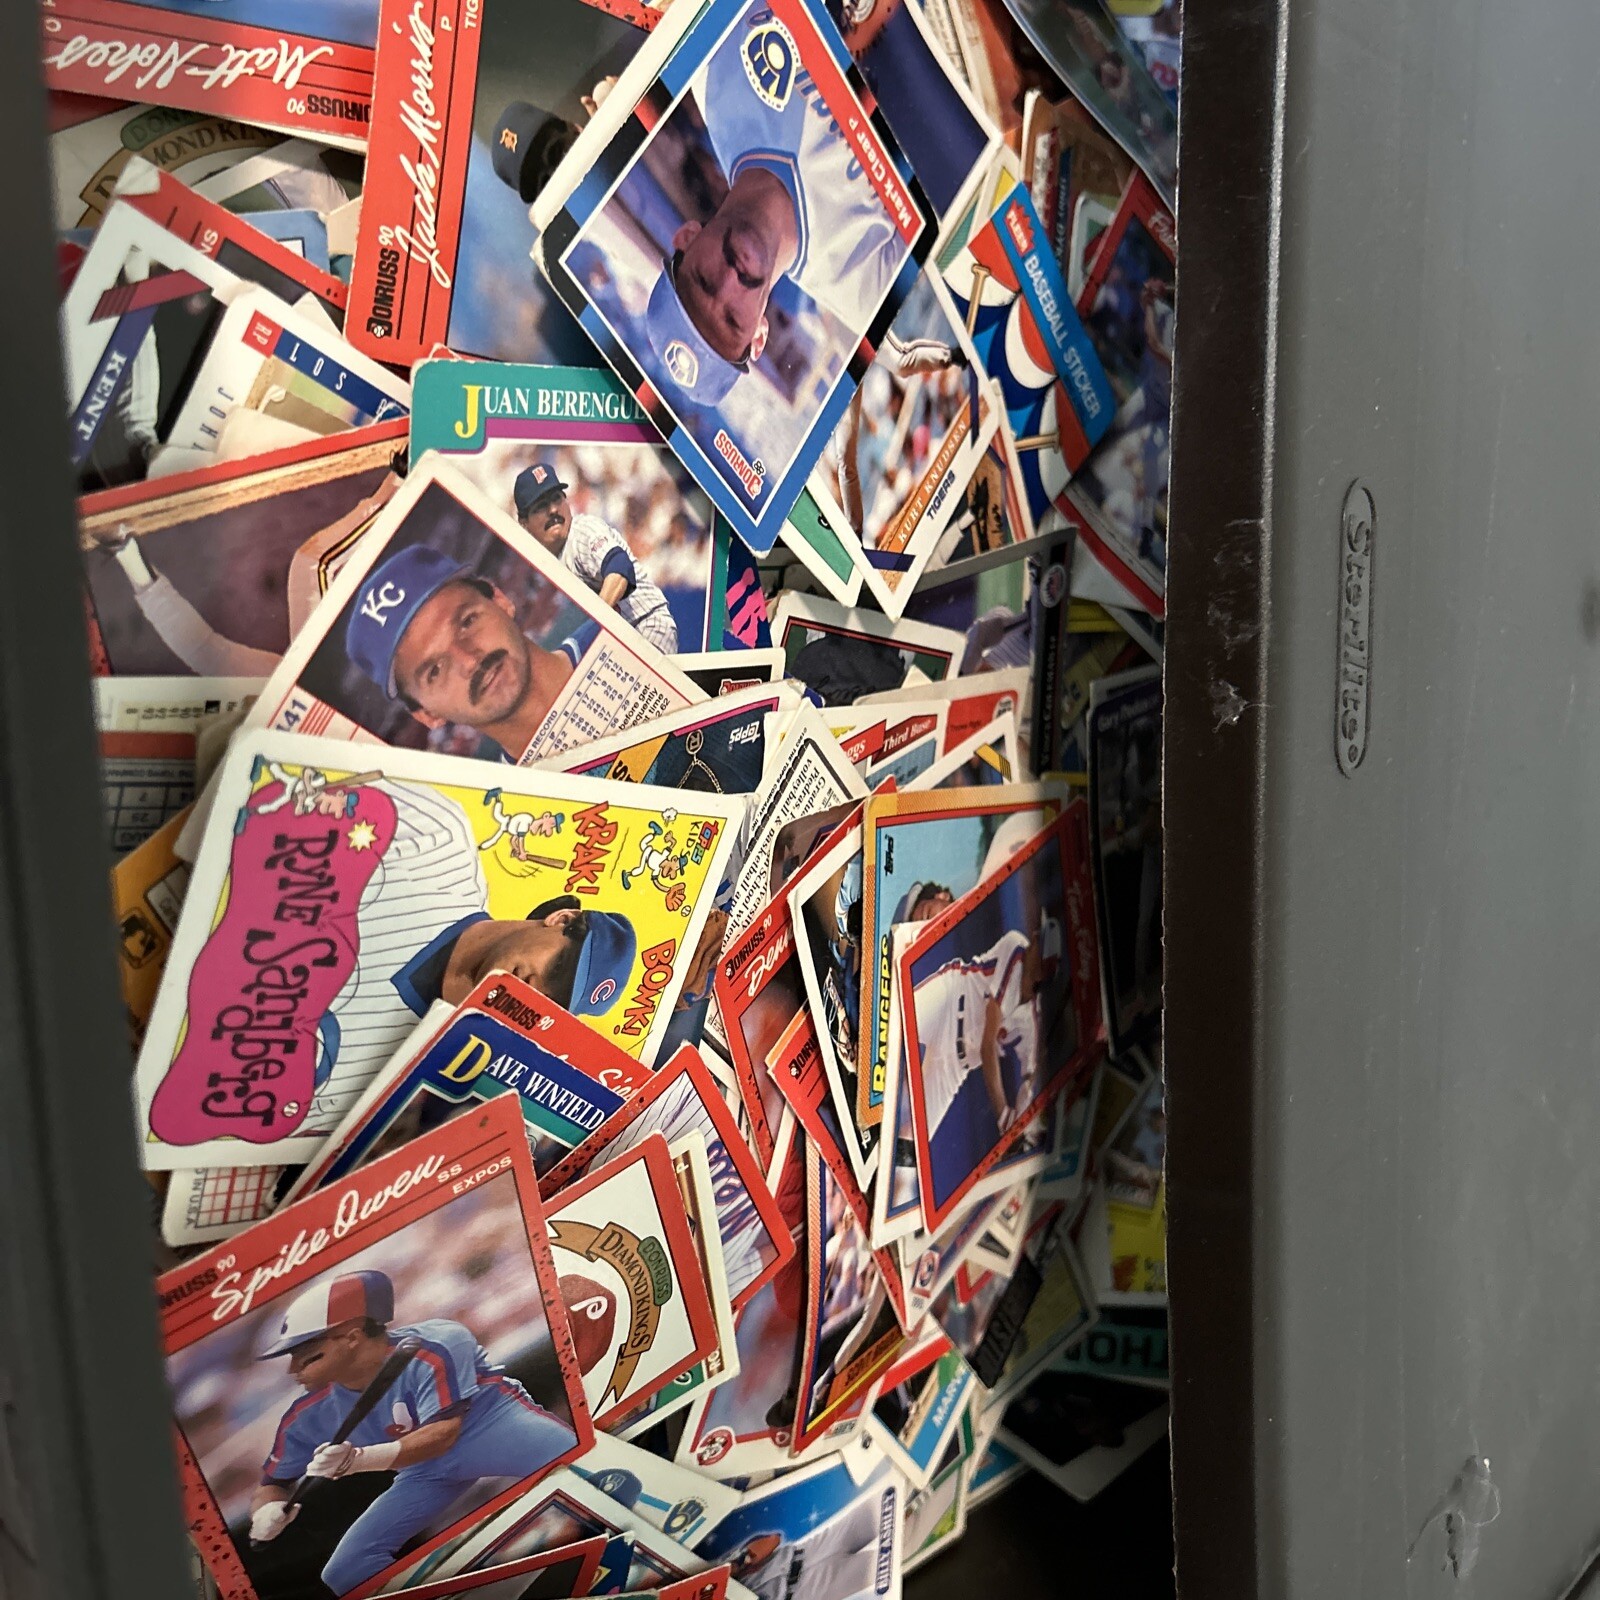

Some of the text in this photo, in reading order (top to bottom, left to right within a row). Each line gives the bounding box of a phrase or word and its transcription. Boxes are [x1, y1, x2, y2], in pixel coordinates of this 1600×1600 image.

[440, 17, 453, 32] P
[43, 35, 334, 91] Matt Nokes
[286, 97, 306, 115] 90
[393, 1, 452, 290] Jack Morris
[849, 117, 912, 229] Mark Clear P
[366, 225, 400, 338] DONRUSS 90
[253, 321, 274, 346] RP
[1024, 254, 1101, 419] BASEBALL STICKER
[288, 342, 347, 392] LOS
[76, 350, 127, 442] KENT
[454, 384, 529, 439] JUAN
[713, 429, 766, 500] DONRUSS 88
[898, 421, 968, 543] KURT KNUDSEN
[925, 469, 956, 520] TIGERS
[361, 581, 405, 628] KC
[553, 658, 614, 750] 49.2 45 17 11 21
[574, 716, 585, 729] 26
[586, 698, 596, 710] 22
[610, 662, 619, 673] 12
[586, 671, 630, 737] 92 37 23 54
[592, 703, 602, 714] 44
[603, 685, 613, 697] 22
[615, 667, 625, 678] 47
[610, 682, 642, 729] 56 29 42
[618, 682, 654, 731] before get-
[648, 693, 665, 715] time
[532, 709, 558, 749] RECORD
[603, 711, 613, 722] 17
[880, 727, 911, 753] Third
[775, 761, 790, 784] TOPPS
[787, 746, 798, 762] THE
[780, 758, 814, 817] volleyball
[792, 767, 821, 813] Piedras,
[680, 821, 703, 861] KIDS
[773, 815, 785, 827] &
[564, 801, 619, 896] KRAK!
[741, 867, 769, 910] School
[725, 913, 773, 981] DONRUSS 90
[483, 984, 555, 1032] DONRUSS 90
[590, 978, 616, 1005] C
[613, 938, 677, 1037] BONK!
[438, 1033, 606, 1131] DAVE WINFIELD
[452, 1155, 513, 1195] EXPOS
[676, 1162, 689, 1174] P
[210, 1154, 463, 1321] Spike Owen SS
[216, 1253, 237, 1272] 90
[642, 1240, 669, 1299] DONRUSS
[599, 1229, 651, 1349] DIAMOND KINGS
